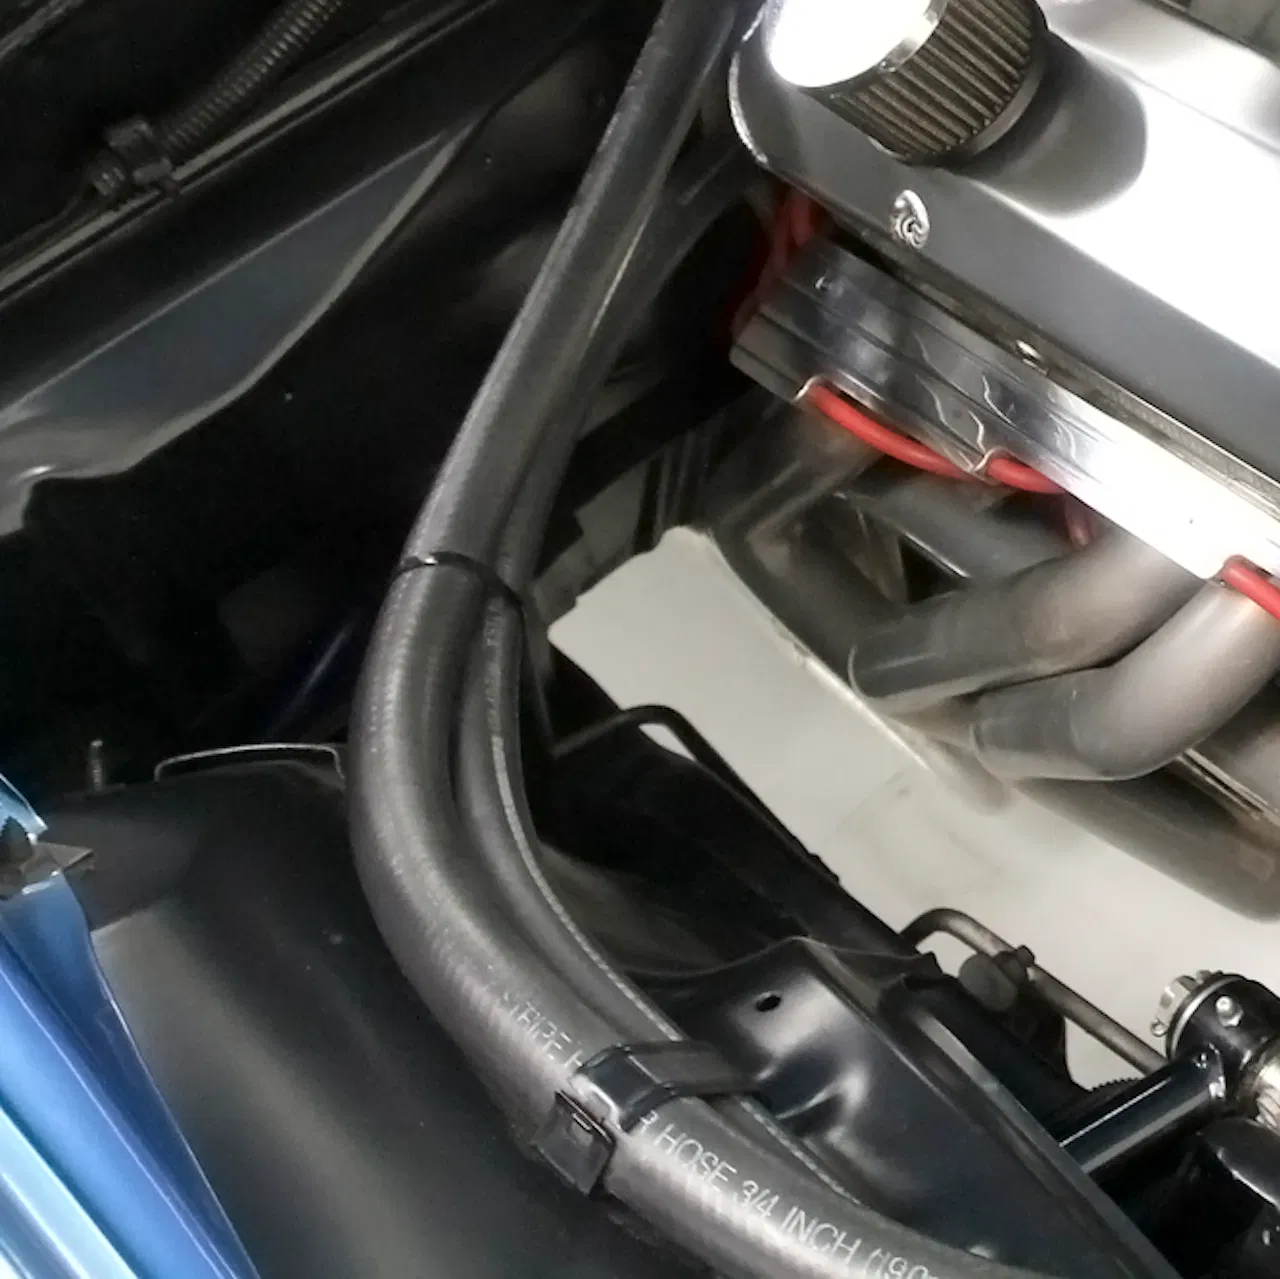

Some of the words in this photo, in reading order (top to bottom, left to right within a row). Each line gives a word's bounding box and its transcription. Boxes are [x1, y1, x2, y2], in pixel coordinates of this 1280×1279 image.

[653, 1123, 737, 1192] HOSE
[733, 1180, 780, 1219] 3/4
[781, 1205, 862, 1272] INCH
